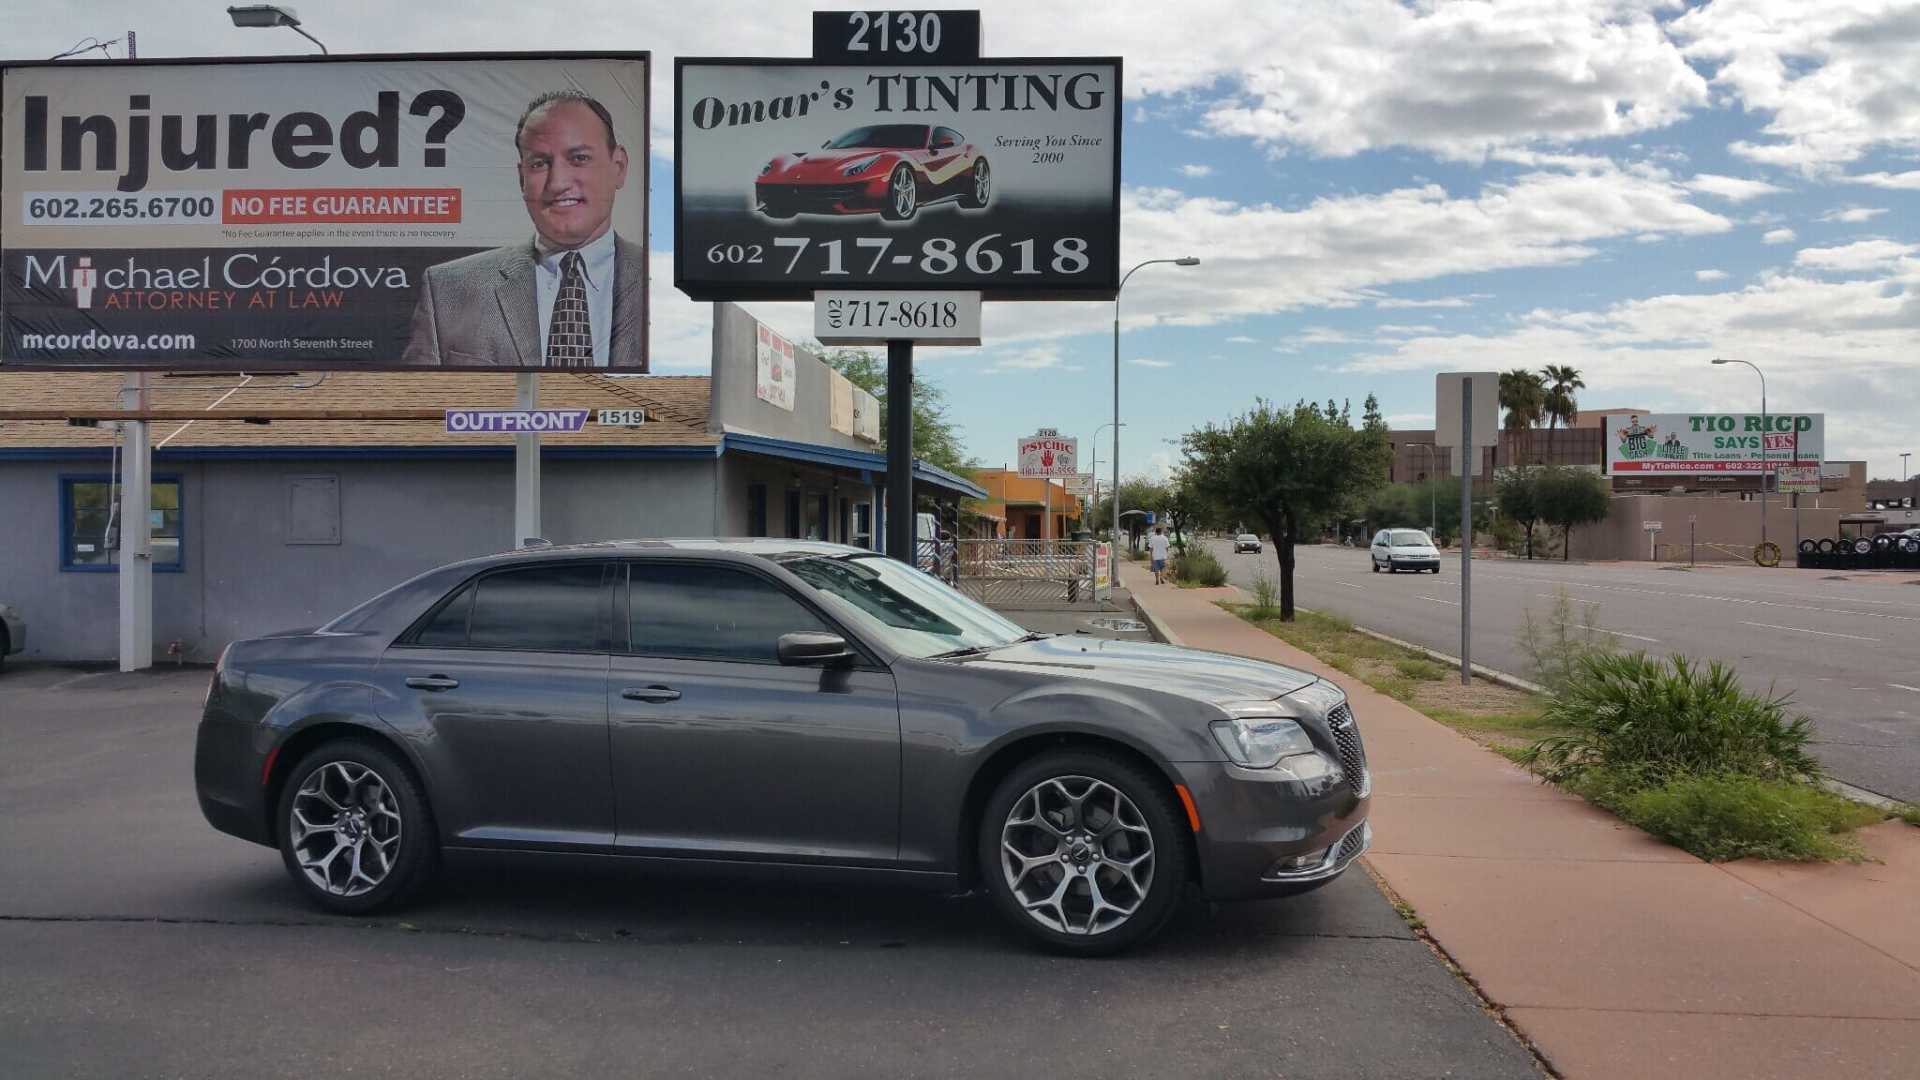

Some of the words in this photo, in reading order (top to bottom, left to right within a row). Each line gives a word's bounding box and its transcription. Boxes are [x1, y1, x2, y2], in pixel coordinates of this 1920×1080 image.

[847, 11, 942, 53] 2130
[692, 80, 855, 130] Omar's
[866, 72, 1105, 112] TINTING
[23, 89, 466, 193] Injured?
[994, 135, 1041, 150] Serving
[1046, 135, 1067, 147] You
[1070, 134, 1103, 147] Since
[1032, 152, 1064, 164] 2000
[29, 197, 215, 218] 602.265.6700
[231, 196, 264, 216] NO
[269, 196, 307, 215] FEE
[239, 230, 253, 239] Fee
[254, 230, 295, 239] Guarantee
[296, 229, 325, 241] applies
[327, 230, 335, 238] in
[336, 229, 350, 238] the
[352, 230, 375, 238] event
[376, 229, 399, 238] there
[400, 230, 406, 238] is
[420, 231, 457, 241] recovery
[706, 243, 764, 264] 602
[773, 233, 1090, 275] 717-8618
[223, 253, 411, 289] Córdova
[104, 290, 237, 310] ATTORNEY
[248, 290, 278, 309] AT
[288, 290, 345, 309] LAW
[828, 299, 844, 329] 602
[847, 301, 958, 329] 717-8618
[23, 329, 196, 350] mcordova.com
[231, 339, 257, 349] 1700
[259, 338, 290, 349] North
[293, 338, 338, 349] Seventh
[340, 338, 374, 349] Street
[450, 412, 581, 431] OUTFRONT
[600, 410, 644, 425] 1519
[1688, 415, 1736, 432] TIO
[1022, 440, 1073, 455] PSYCHIC
[1628, 435, 1648, 450] BIG
[1714, 436, 1760, 449] SAYS
[1765, 435, 1794, 448] YES
